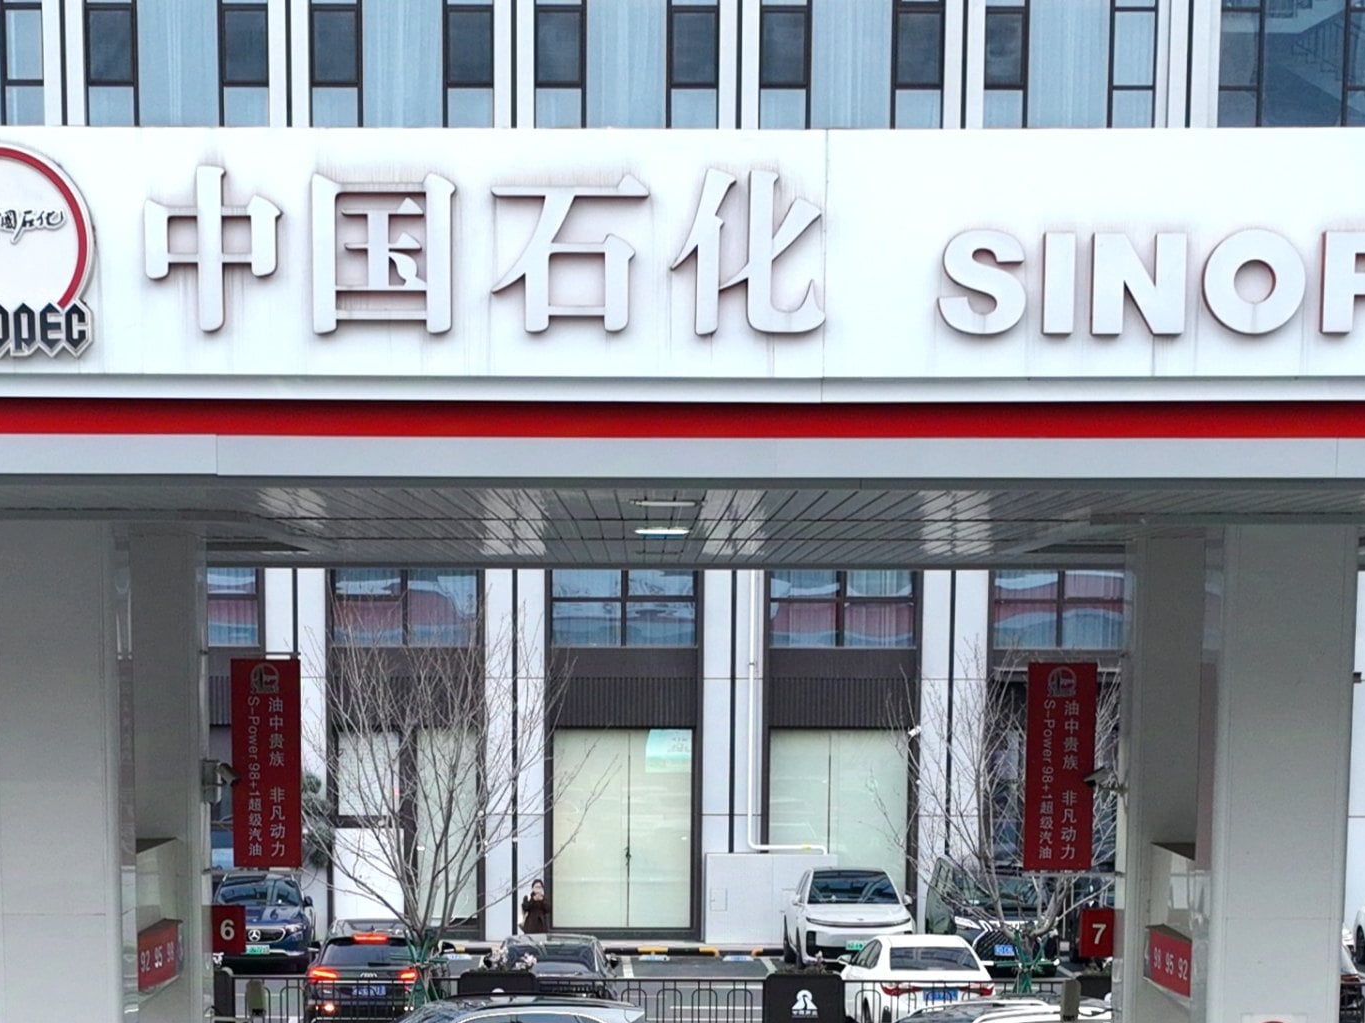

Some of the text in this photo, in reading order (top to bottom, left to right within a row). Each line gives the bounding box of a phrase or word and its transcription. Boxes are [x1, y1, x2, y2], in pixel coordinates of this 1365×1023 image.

[142, 160, 827, 339] 中国石化
[268, 697, 286, 857] 油中贵族 非凡动力
[1060, 700, 1080, 860] 油中贵族 非凡动力
[220, 919, 235, 940] 6
[1092, 923, 1106, 944] 7
[140, 950, 151, 973] 92
[155, 945, 163, 969] 95
[1165, 952, 1174, 975] 95
[1178, 957, 1188, 980] 92
